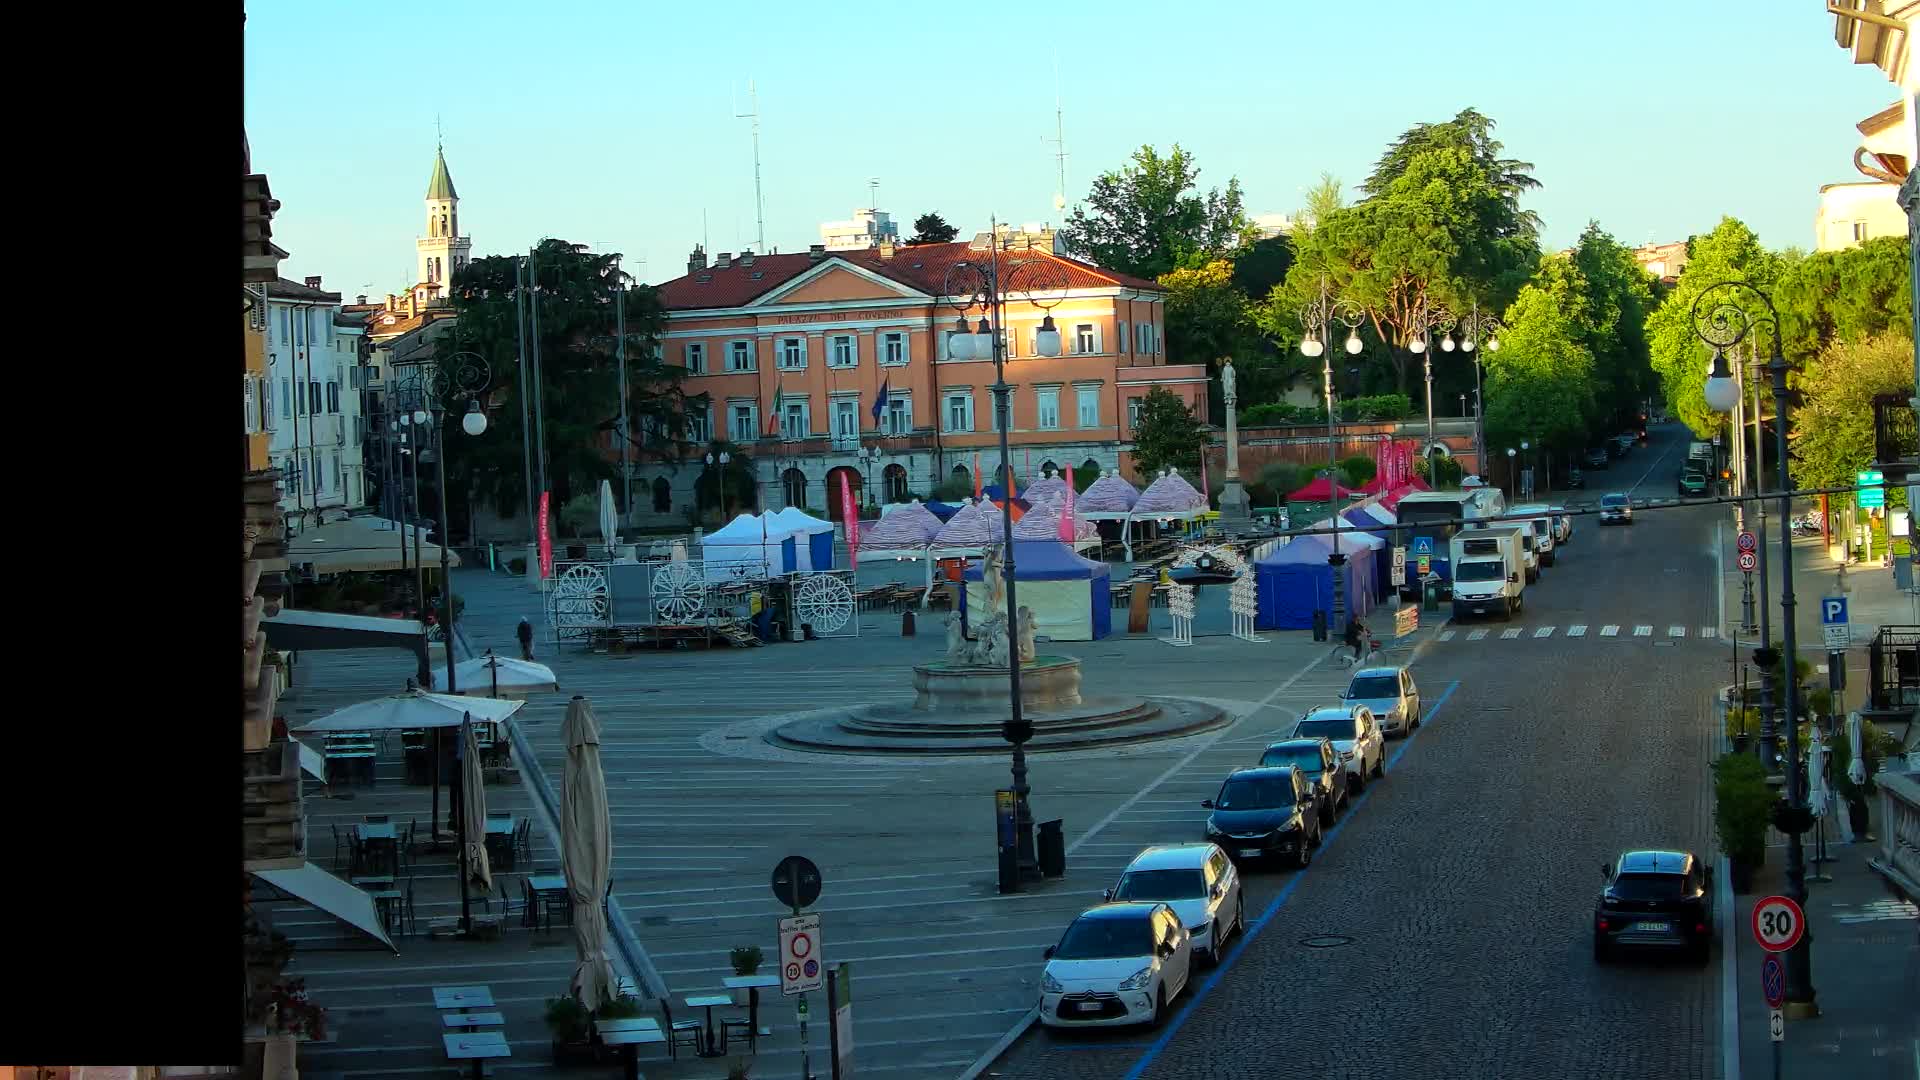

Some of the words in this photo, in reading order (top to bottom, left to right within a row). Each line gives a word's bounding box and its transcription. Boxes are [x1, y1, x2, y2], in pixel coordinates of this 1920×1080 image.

[1742, 557, 1753, 566] 20
[1827, 601, 1842, 621] P
[1762, 910, 1792, 937] 30
